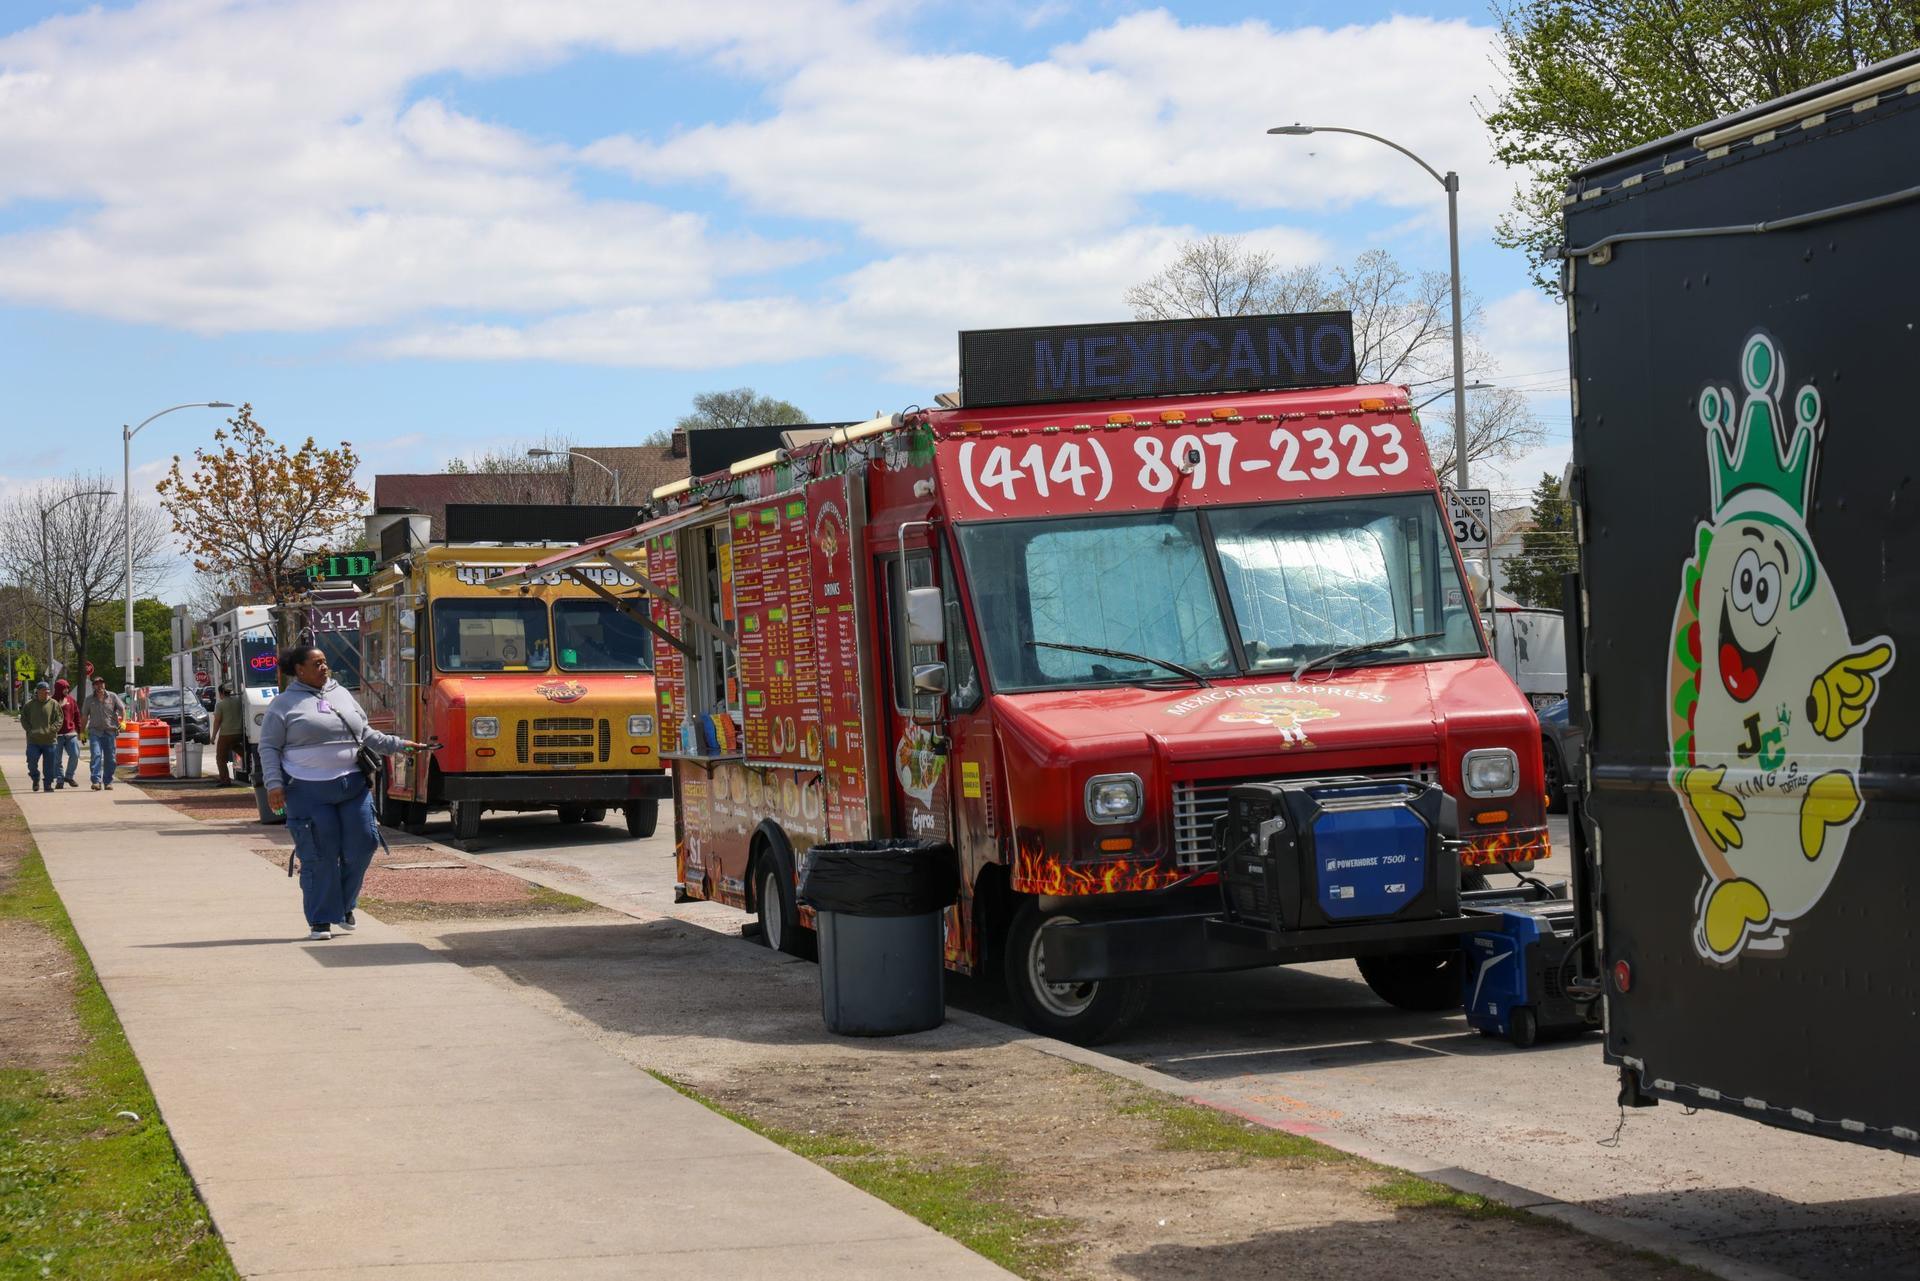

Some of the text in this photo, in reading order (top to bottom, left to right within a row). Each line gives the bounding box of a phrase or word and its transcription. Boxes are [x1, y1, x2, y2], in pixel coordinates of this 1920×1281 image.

[1034, 323, 1350, 391] MEXICANO
[957, 423, 1409, 512] (414) 897-2323
[1450, 496, 1486, 507] SPEED
[1453, 520, 1487, 543] 30
[320, 610, 360, 629] 414
[250, 656, 279, 668] OPEN
[1166, 684, 1387, 717] MEXICANO EXPRESS
[1735, 761, 1799, 800] KING'S
[1779, 774, 1809, 795] TORTAS
[912, 807, 935, 836] Gyros
[1336, 854, 1406, 869] POWERHORSE 7500i
